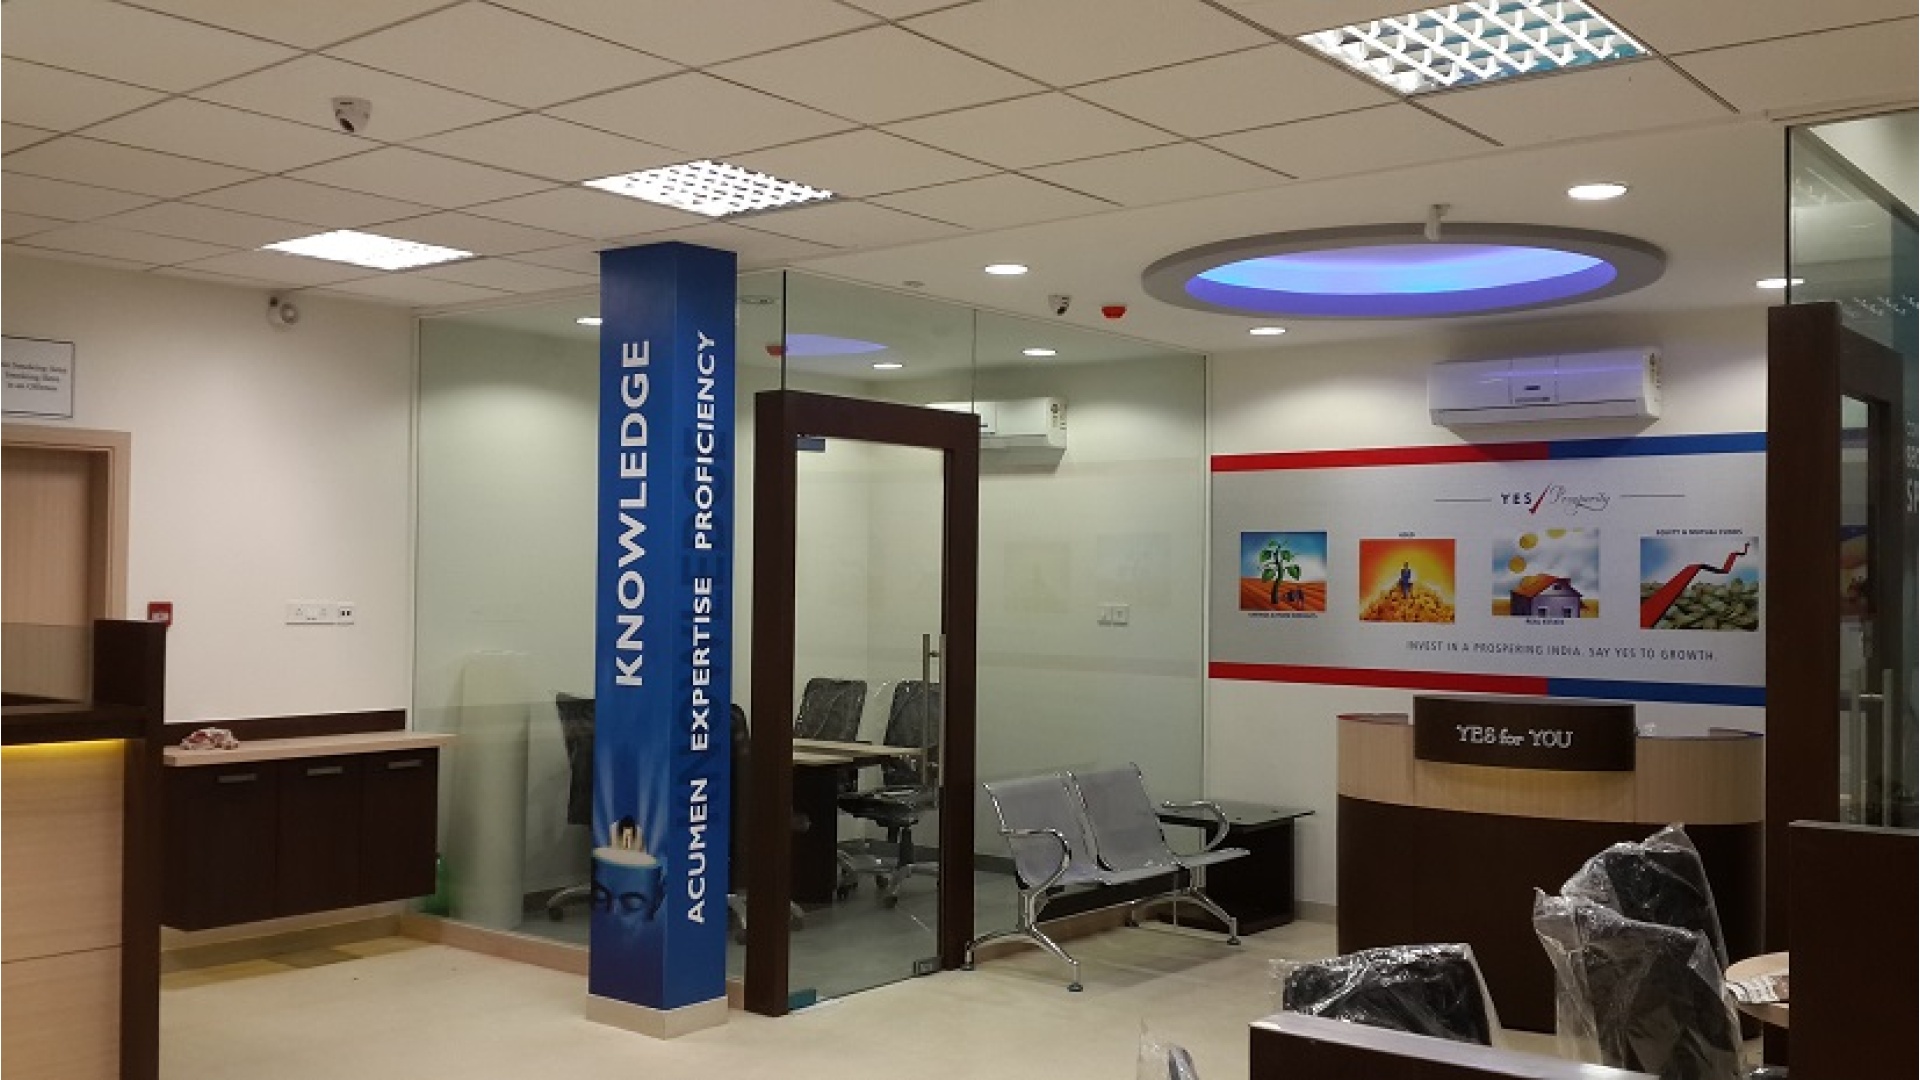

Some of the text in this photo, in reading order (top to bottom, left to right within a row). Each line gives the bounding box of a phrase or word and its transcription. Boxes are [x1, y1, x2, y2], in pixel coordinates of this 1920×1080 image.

[616, 340, 650, 686] KNOWLEDGE
[1500, 491, 1532, 505] YES
[676, 427, 726, 827] KNOWLEDGE
[687, 330, 716, 924] ACUMEN EXPERTISE PROFICIENCY
[1406, 640, 1444, 651] INVEST
[1447, 642, 1458, 651] IN
[1461, 642, 1470, 652] A
[1473, 642, 1544, 656] PROSPERING
[1588, 647, 1611, 658] SAY
[1614, 647, 1637, 658] YES
[1640, 647, 1655, 660] TO
[1456, 724, 1574, 748] YES for YOU
